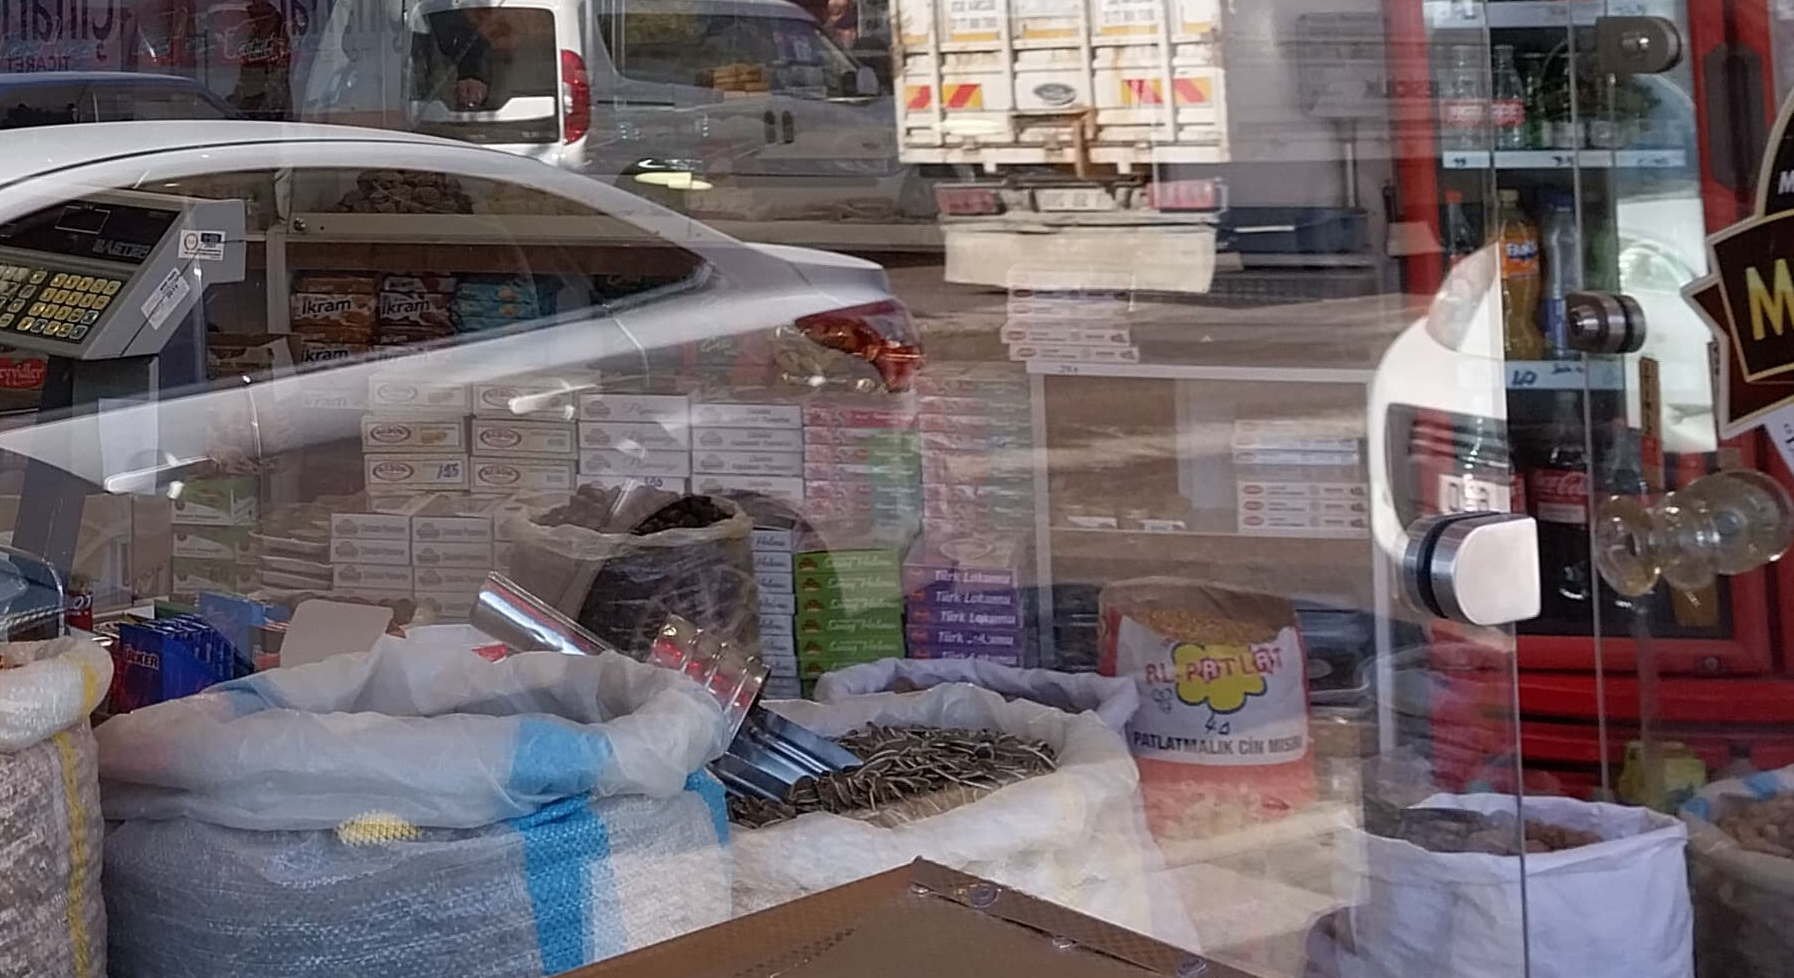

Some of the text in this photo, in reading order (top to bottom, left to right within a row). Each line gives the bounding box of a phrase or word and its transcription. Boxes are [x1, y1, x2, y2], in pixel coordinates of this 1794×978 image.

[301, 296, 352, 317] ikram
[381, 297, 431, 317] ikram
[300, 347, 349, 364] ikram
[934, 590, 961, 603] Türk
[1133, 730, 1234, 755] PATLATMALIK
